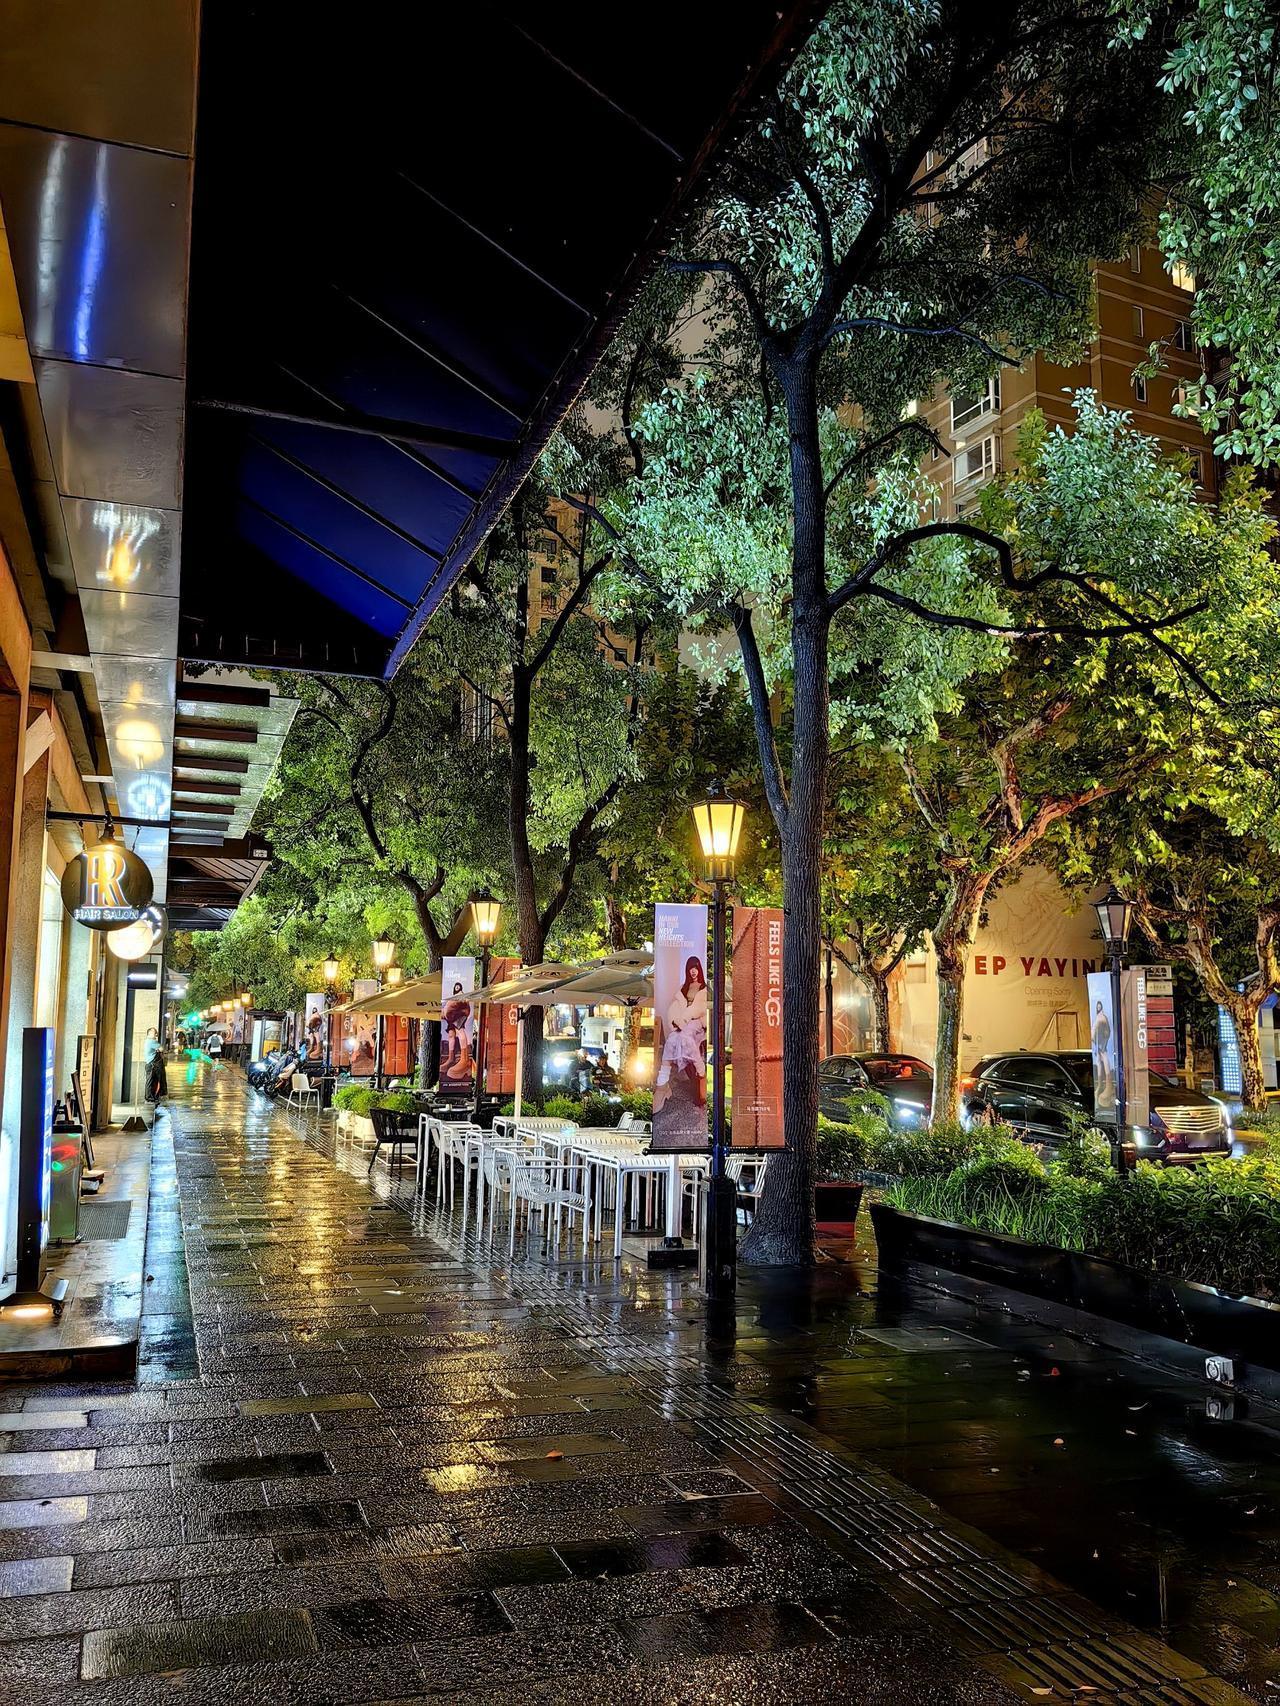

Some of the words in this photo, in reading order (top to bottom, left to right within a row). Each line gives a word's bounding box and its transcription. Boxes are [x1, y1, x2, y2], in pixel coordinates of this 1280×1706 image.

[74, 908, 101, 920] HAIR
[102, 908, 139, 920] SALON
[768, 920, 781, 956] FEELS
[768, 958, 780, 985] LIKE
[974, 955, 1007, 976] EP
[765, 988, 781, 1027] UGG
